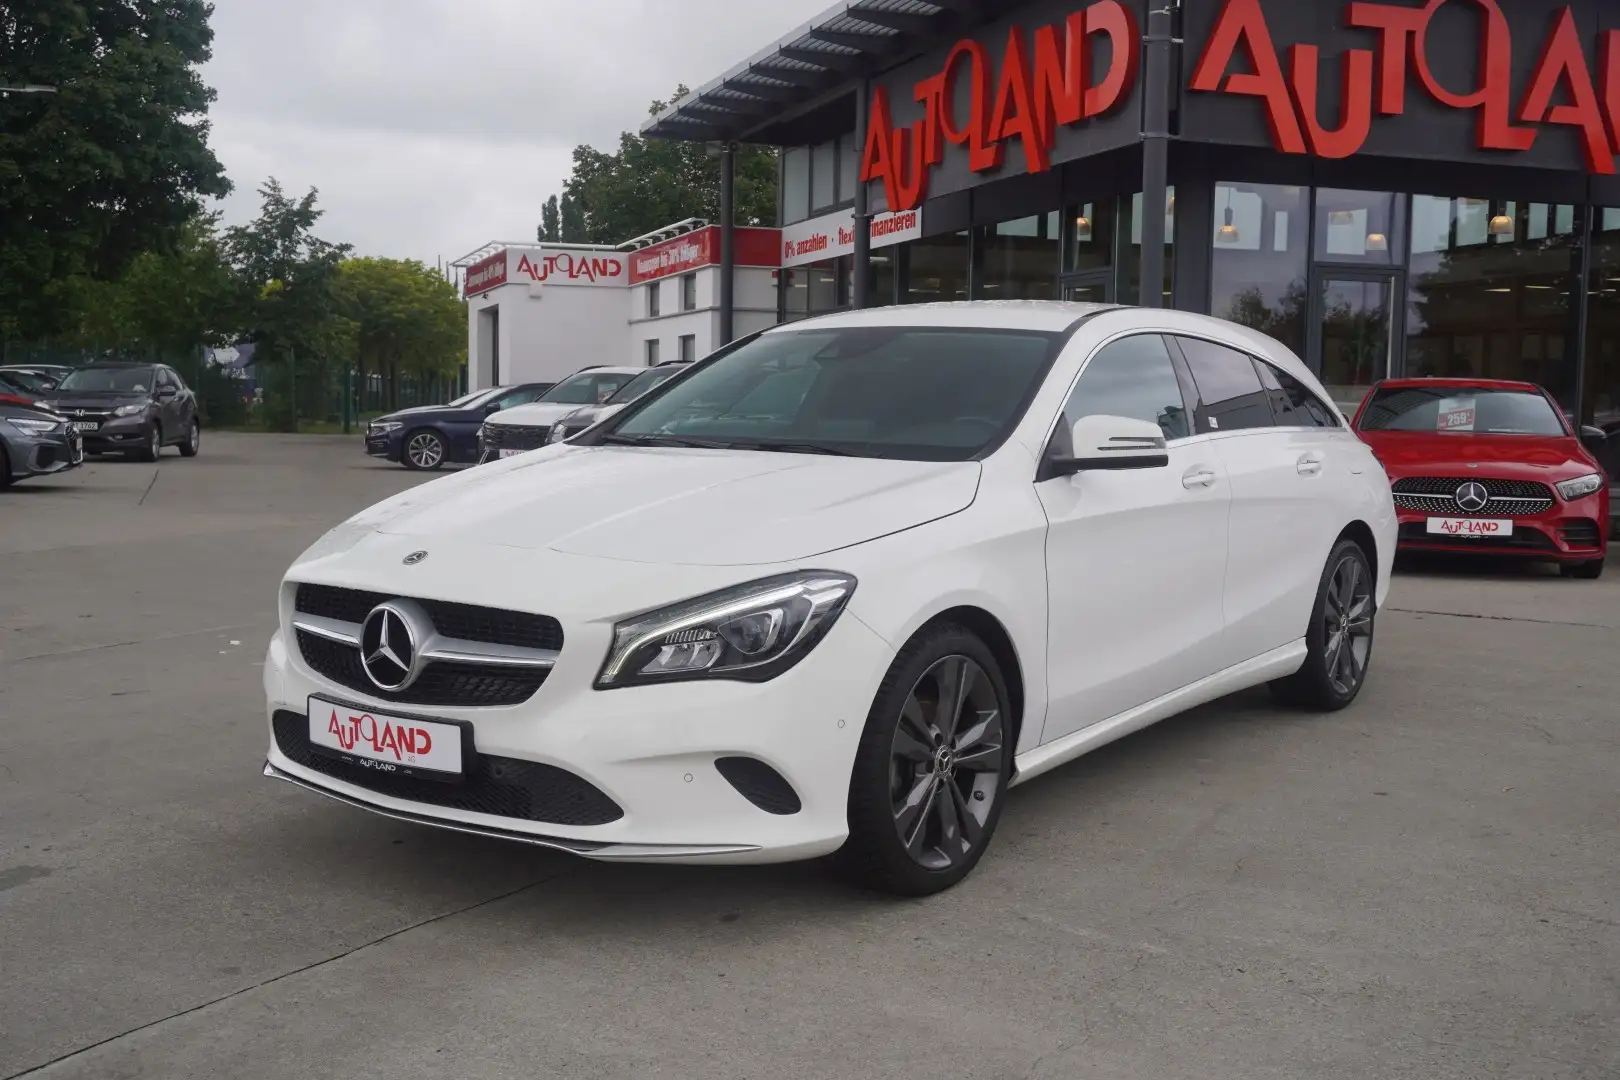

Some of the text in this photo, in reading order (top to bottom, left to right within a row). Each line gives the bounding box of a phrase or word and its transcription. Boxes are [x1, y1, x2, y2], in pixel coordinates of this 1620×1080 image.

[860, 0, 1138, 212] AUTOLAND
[1188, 0, 1620, 175] AUTOLA
[785, 241, 796, 258] 0%
[797, 233, 827, 255] anzahlen
[870, 211, 916, 238] inanzieren
[517, 252, 622, 282] AUTOLAND
[1441, 519, 1499, 534] AUTOLAND
[328, 708, 432, 761] AUTOLAND
[360, 758, 396, 772] AUTOLAND
